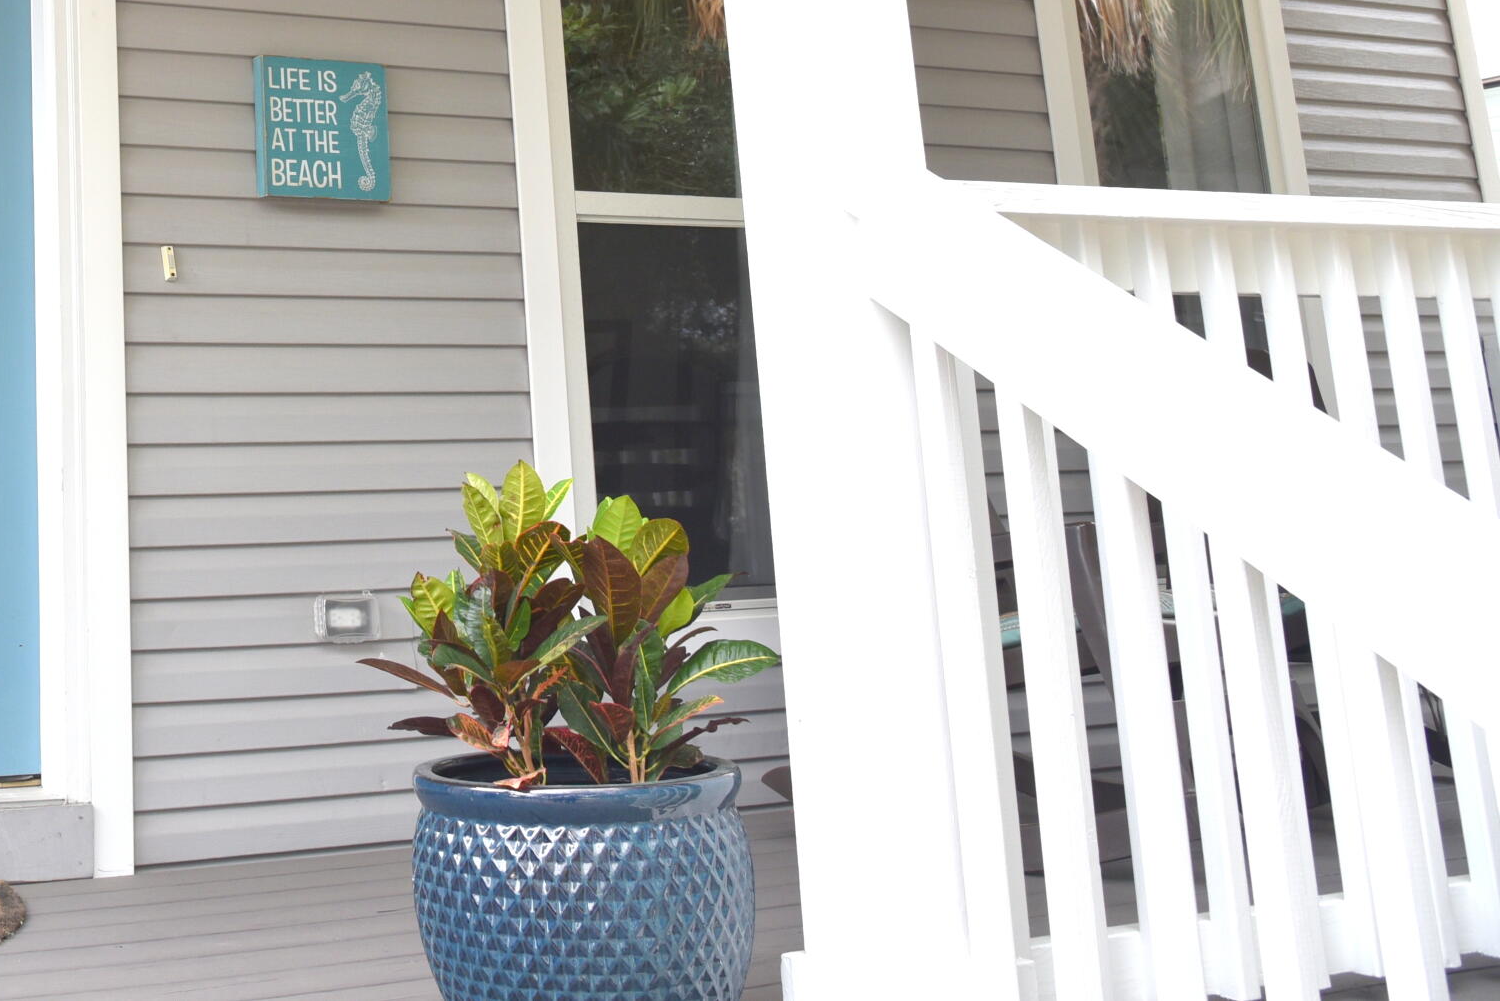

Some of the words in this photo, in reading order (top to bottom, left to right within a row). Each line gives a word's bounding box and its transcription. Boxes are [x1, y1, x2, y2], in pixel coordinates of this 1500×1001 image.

[268, 66, 311, 91] LIFE
[317, 70, 337, 93] IS
[269, 96, 338, 126] BETTER
[271, 127, 297, 152] AT
[302, 129, 340, 154] THE
[271, 158, 342, 189] BEACH
